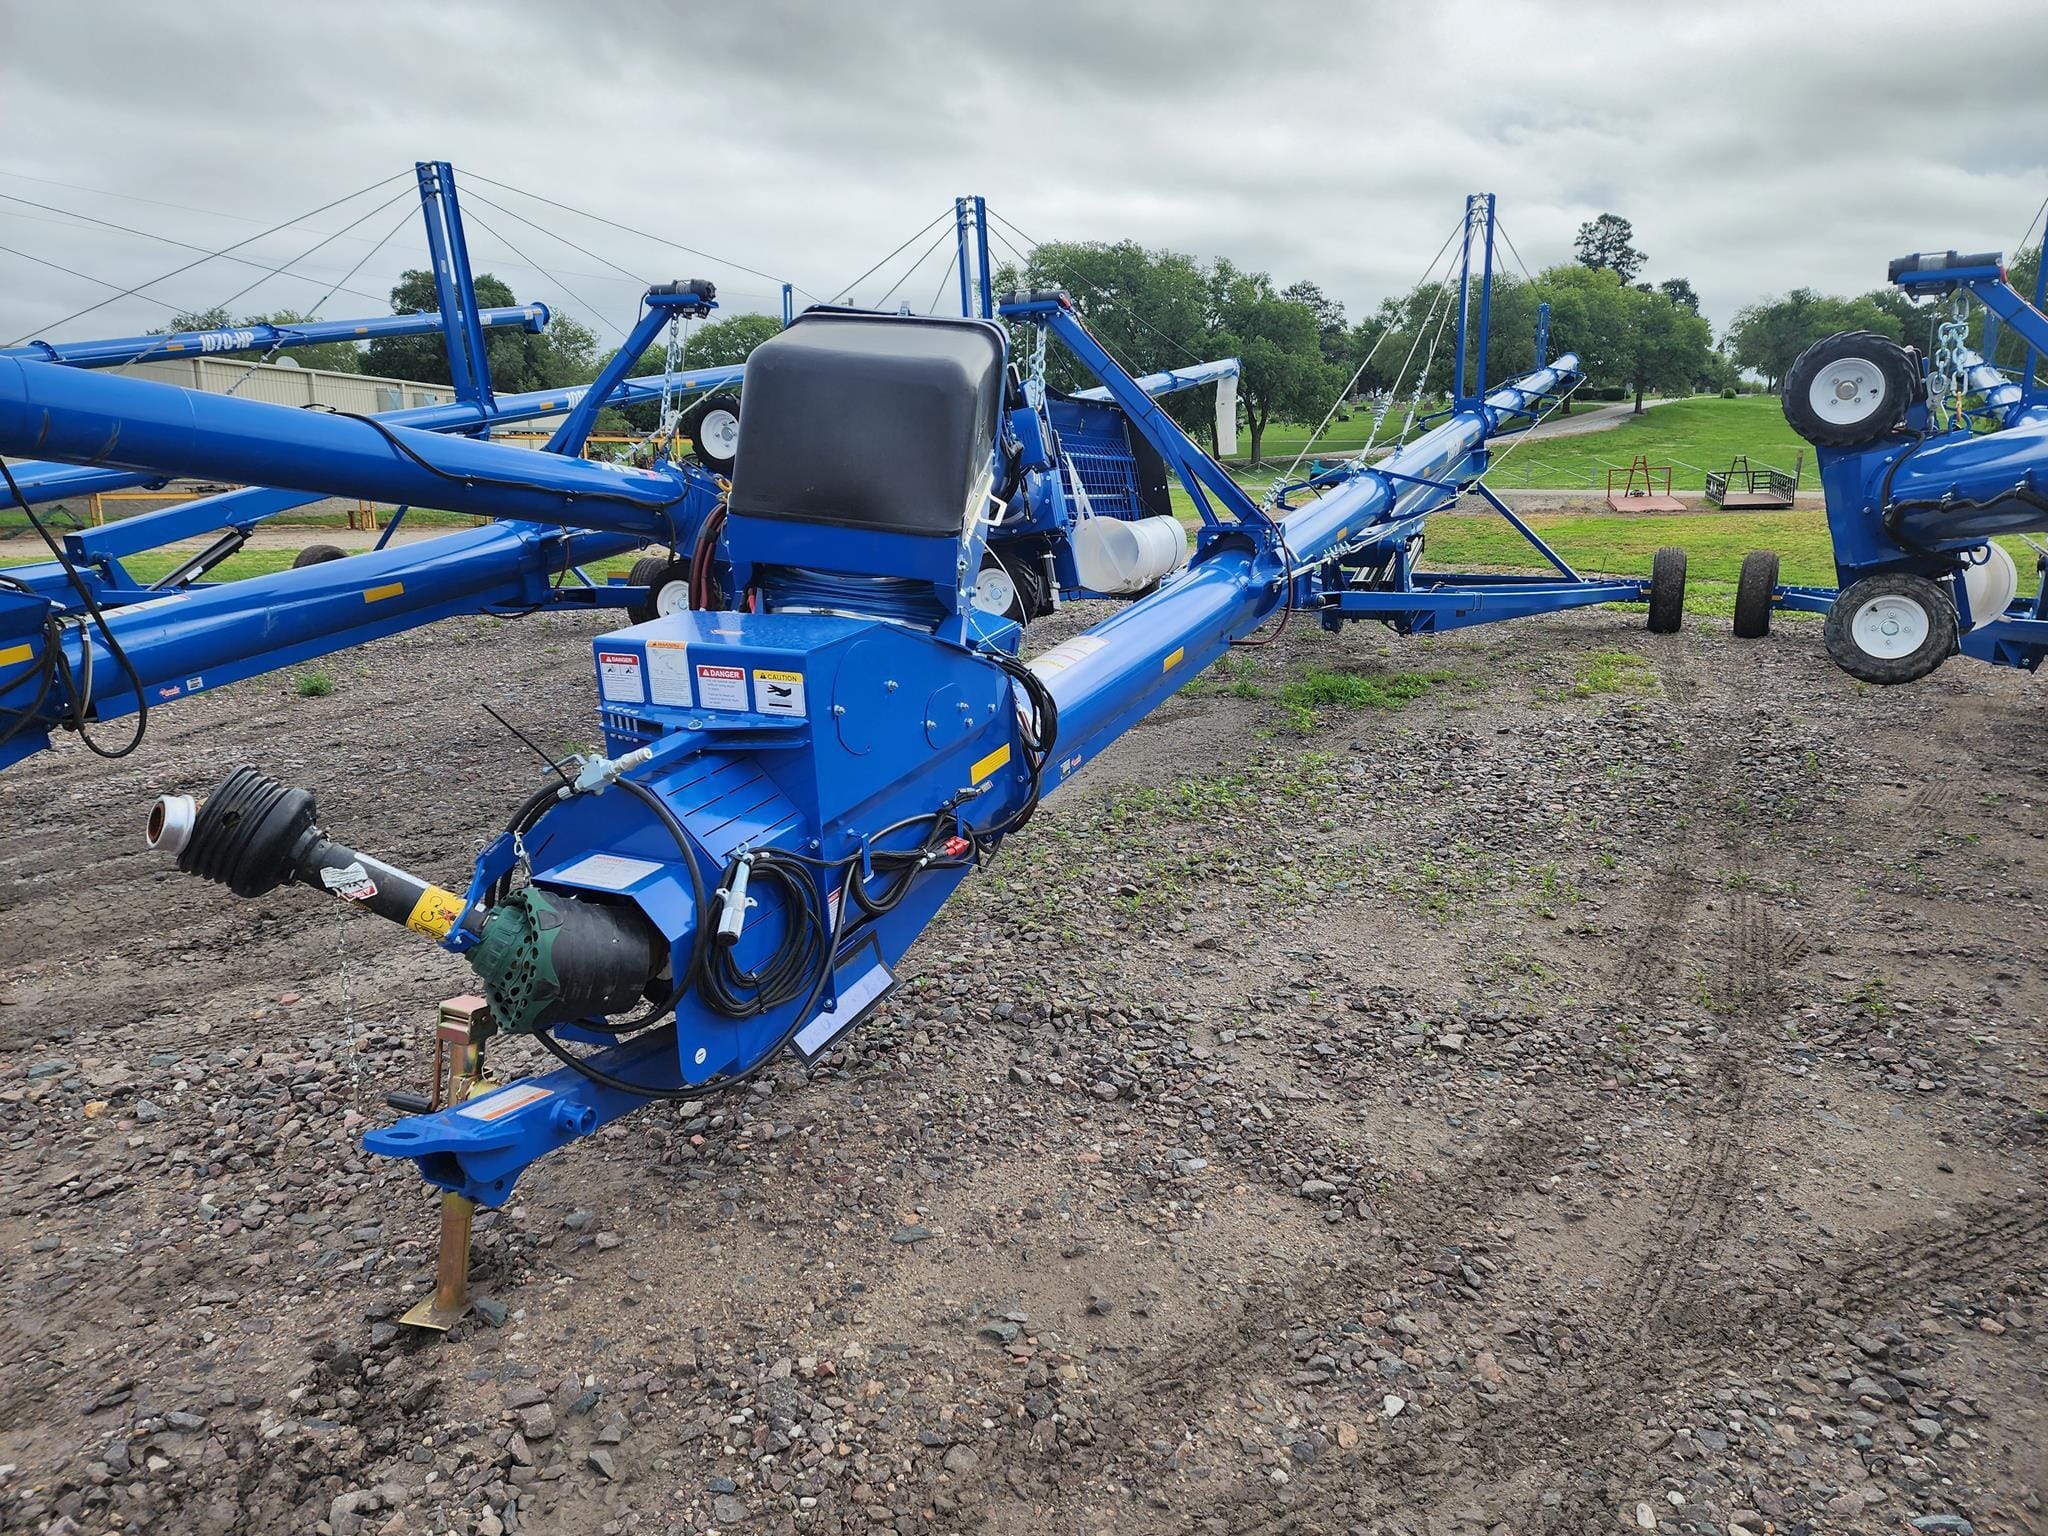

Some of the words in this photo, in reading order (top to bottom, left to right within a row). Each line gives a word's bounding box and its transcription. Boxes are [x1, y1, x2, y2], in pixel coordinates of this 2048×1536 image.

[198, 331, 255, 352] 1070-HP
[611, 656, 633, 664] DANGER
[709, 669, 741, 679] DANGER
[767, 673, 798, 682] CAUTION
